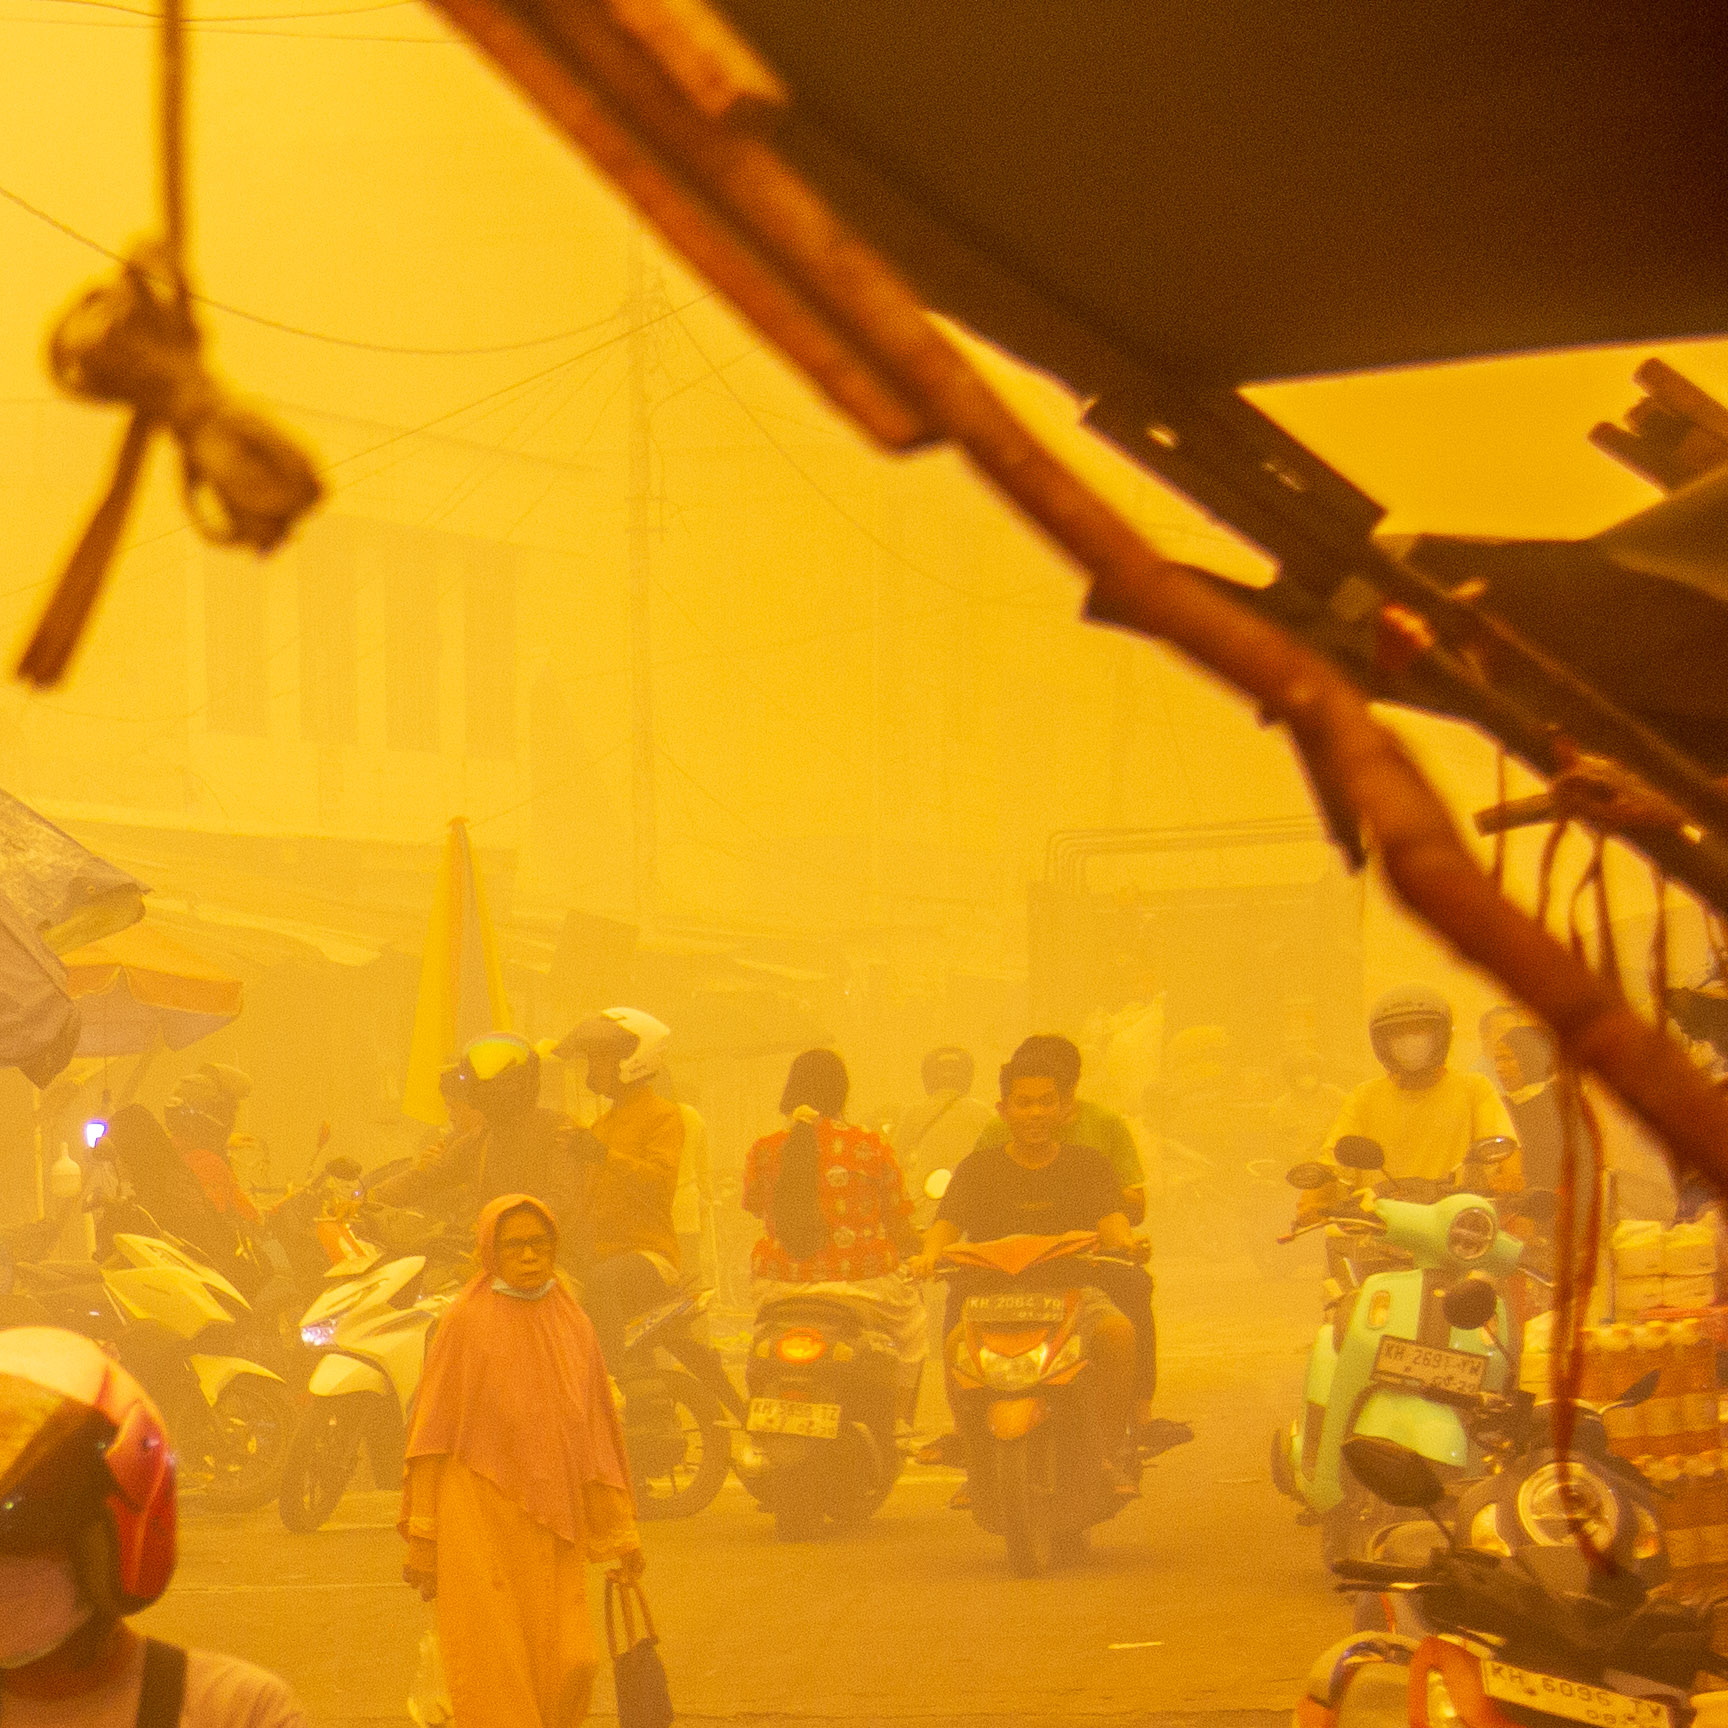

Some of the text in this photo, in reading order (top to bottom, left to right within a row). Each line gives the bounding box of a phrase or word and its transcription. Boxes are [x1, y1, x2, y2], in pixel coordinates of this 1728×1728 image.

[1385, 1343, 1406, 1361] KH
[1491, 1664, 1663, 1719] KH 6096 TV
